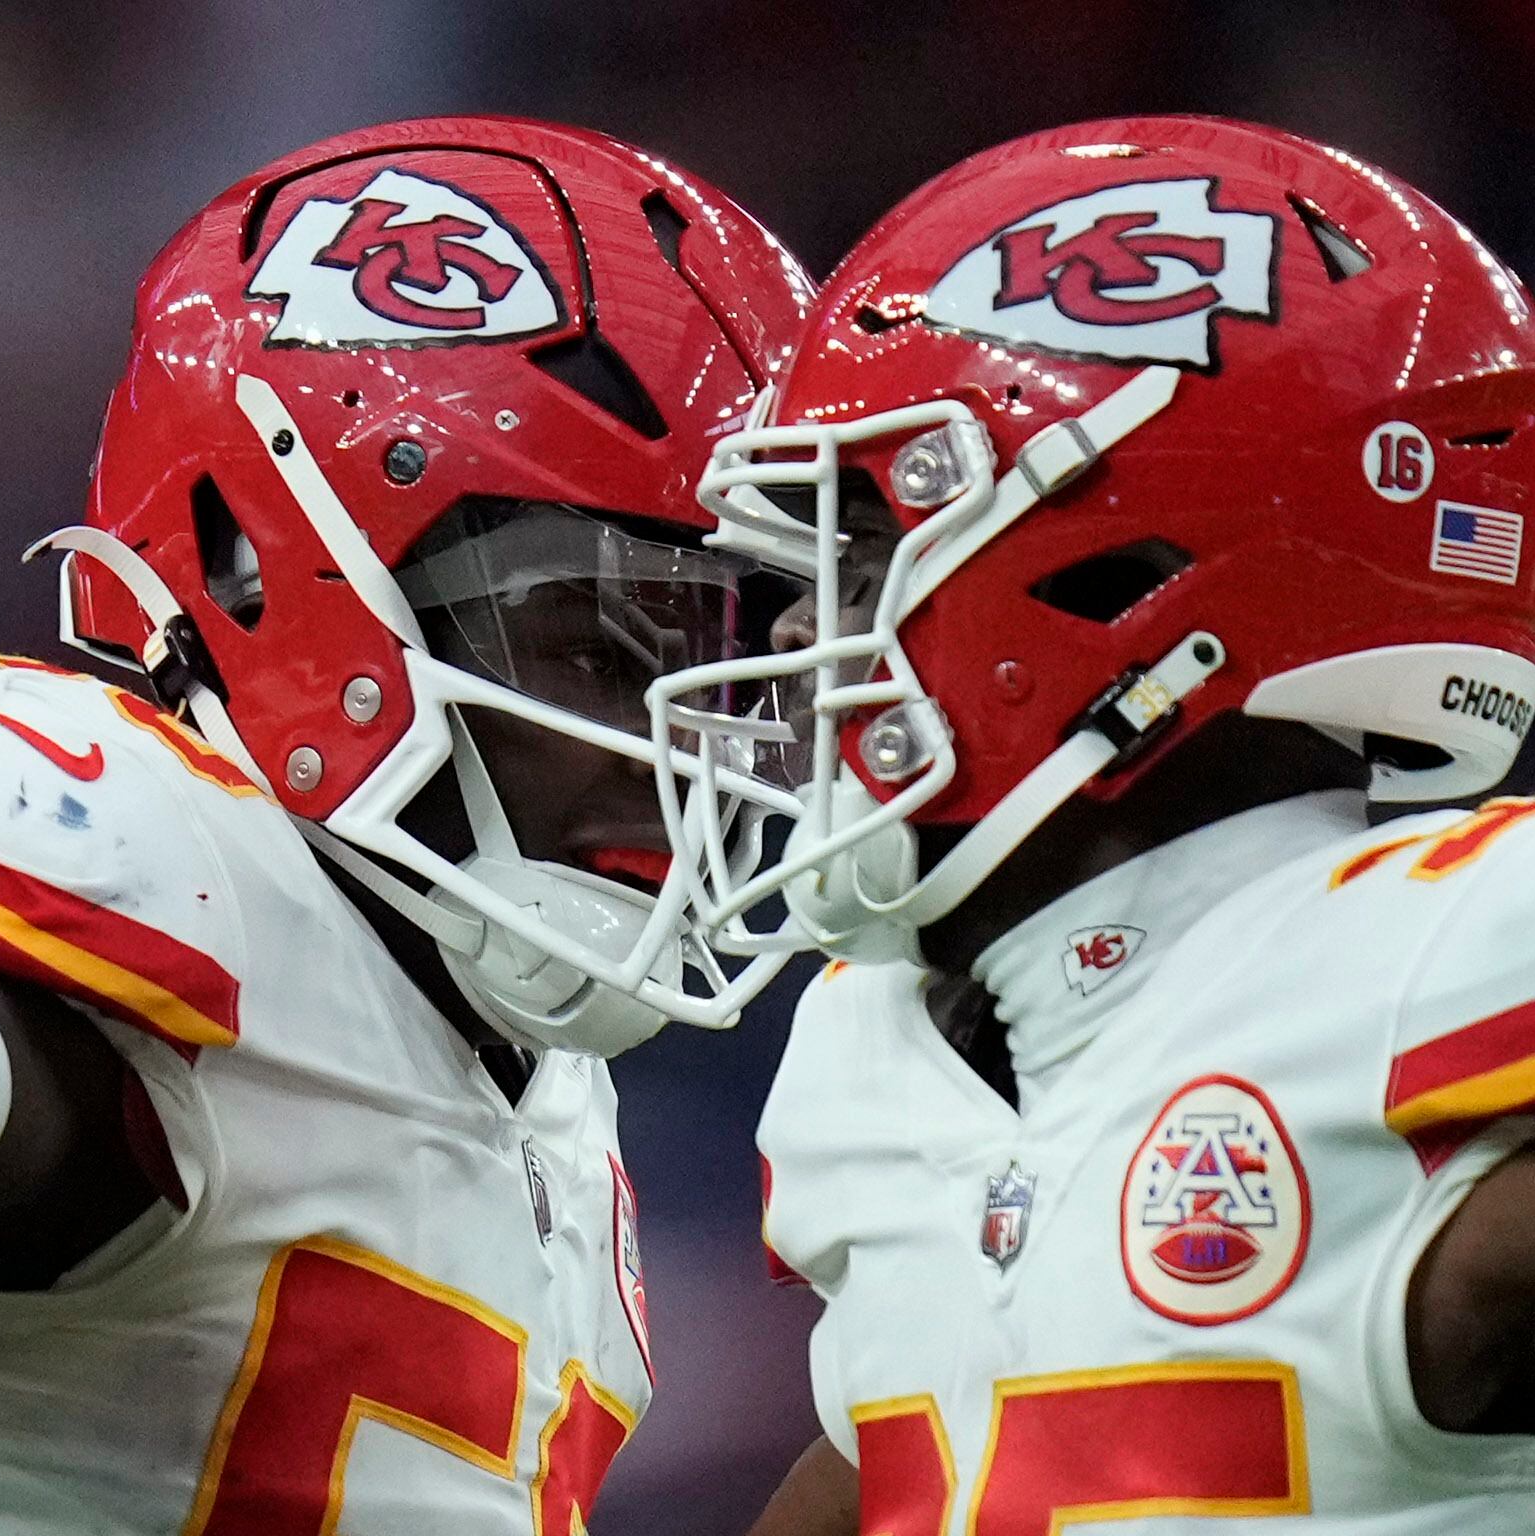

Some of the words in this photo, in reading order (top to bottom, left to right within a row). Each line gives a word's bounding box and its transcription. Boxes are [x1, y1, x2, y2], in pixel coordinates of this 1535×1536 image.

[311, 198, 524, 331] KC
[993, 211, 1224, 326] KC
[1377, 433, 1423, 491] 16
[1075, 932, 1127, 969] KC
